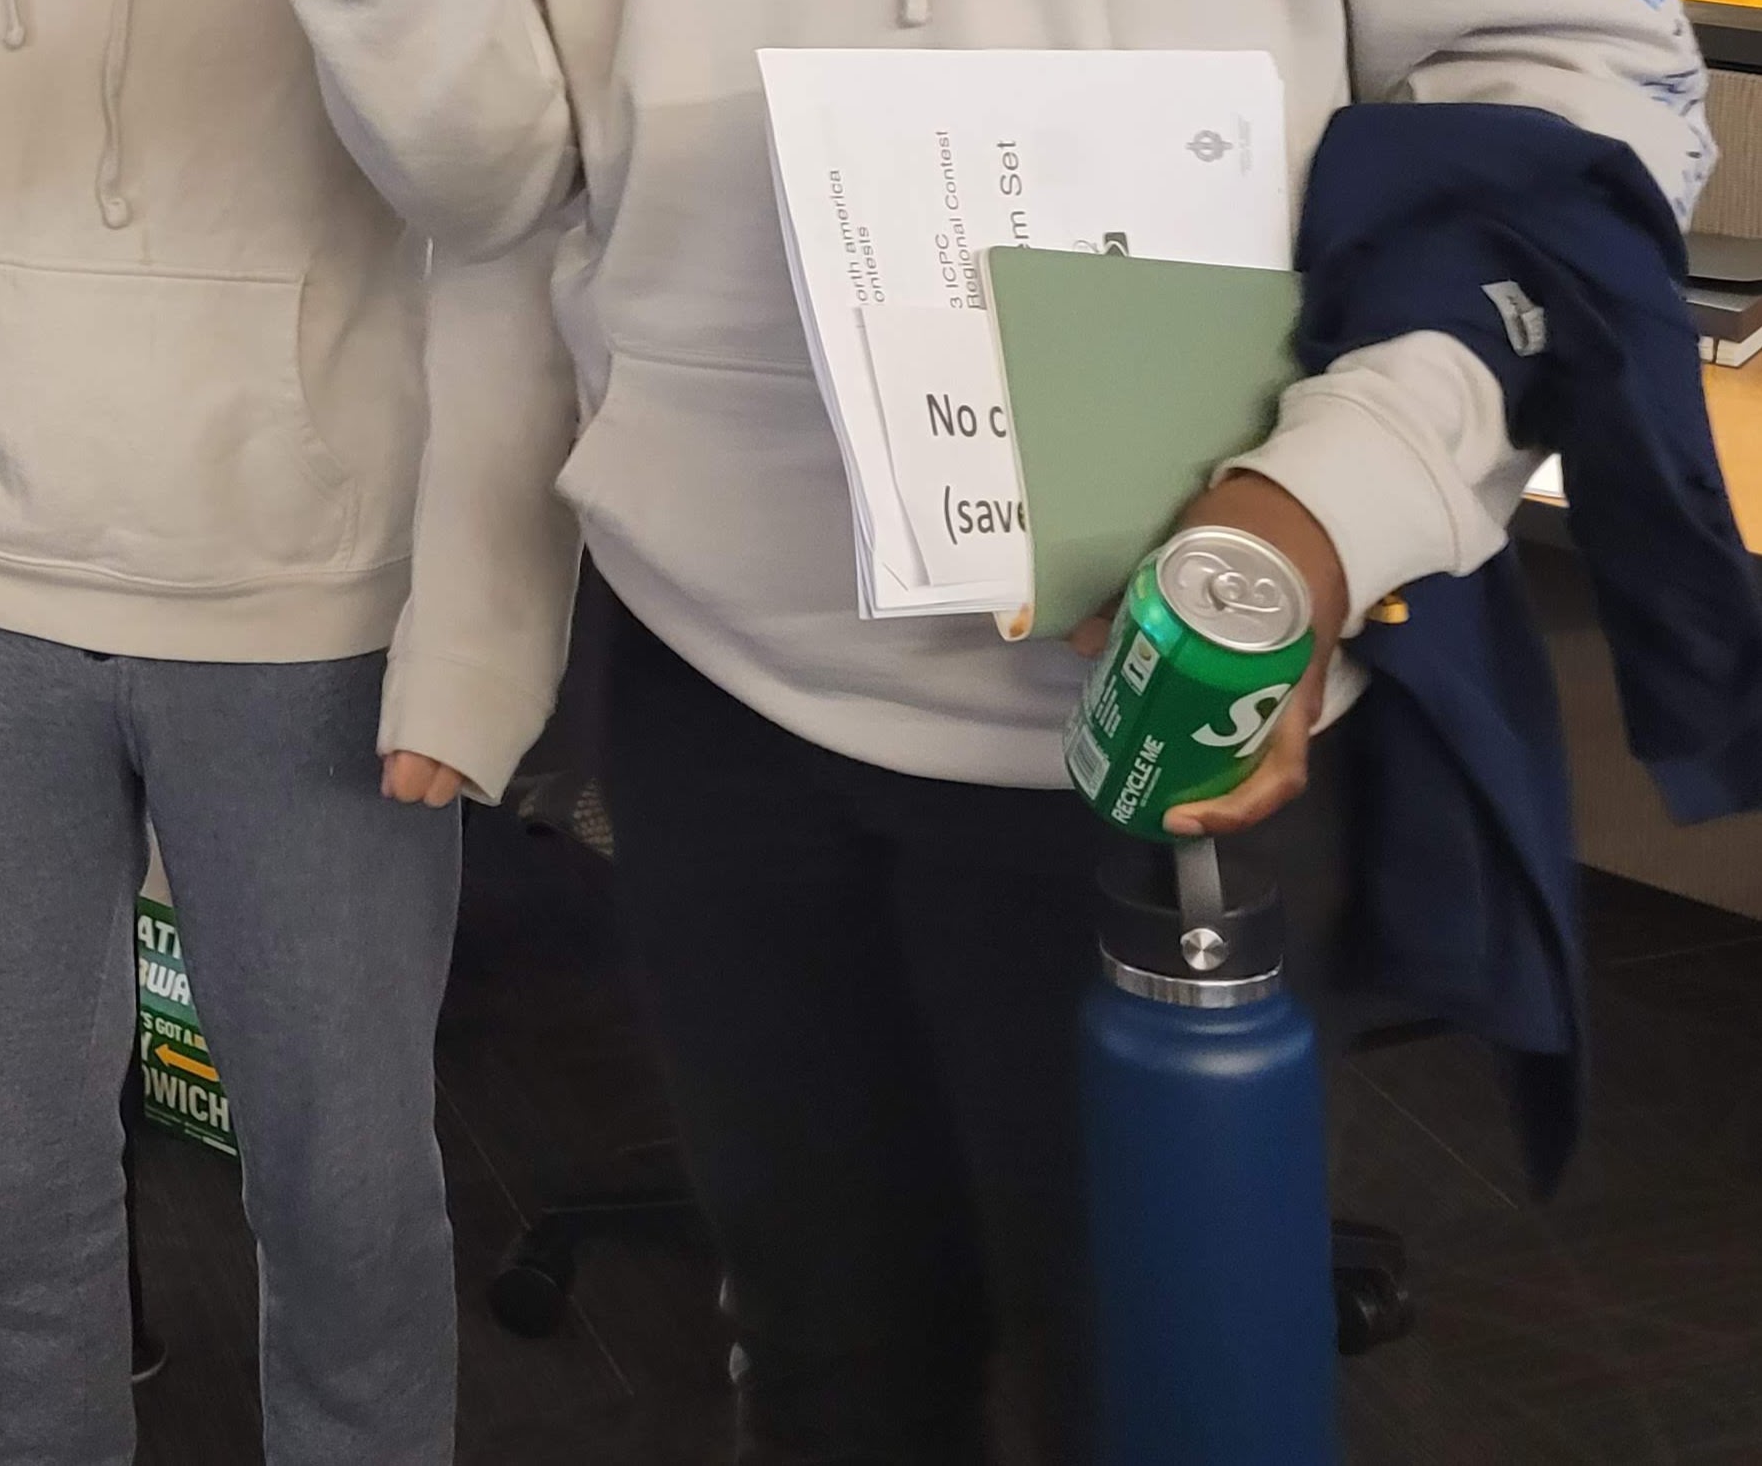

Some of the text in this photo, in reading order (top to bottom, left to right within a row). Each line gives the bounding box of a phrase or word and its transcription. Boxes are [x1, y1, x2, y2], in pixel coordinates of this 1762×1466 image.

[996, 139, 1023, 196] Set
[935, 130, 983, 310] Regional Contest
[847, 261, 870, 305] orth
[857, 226, 886, 304] ontests
[934, 233, 960, 288] ICPC
[926, 393, 978, 438] No
[1111, 757, 1155, 825] RECYCLE
[1140, 734, 1166, 764] ME
[154, 1016, 183, 1043] GOT
